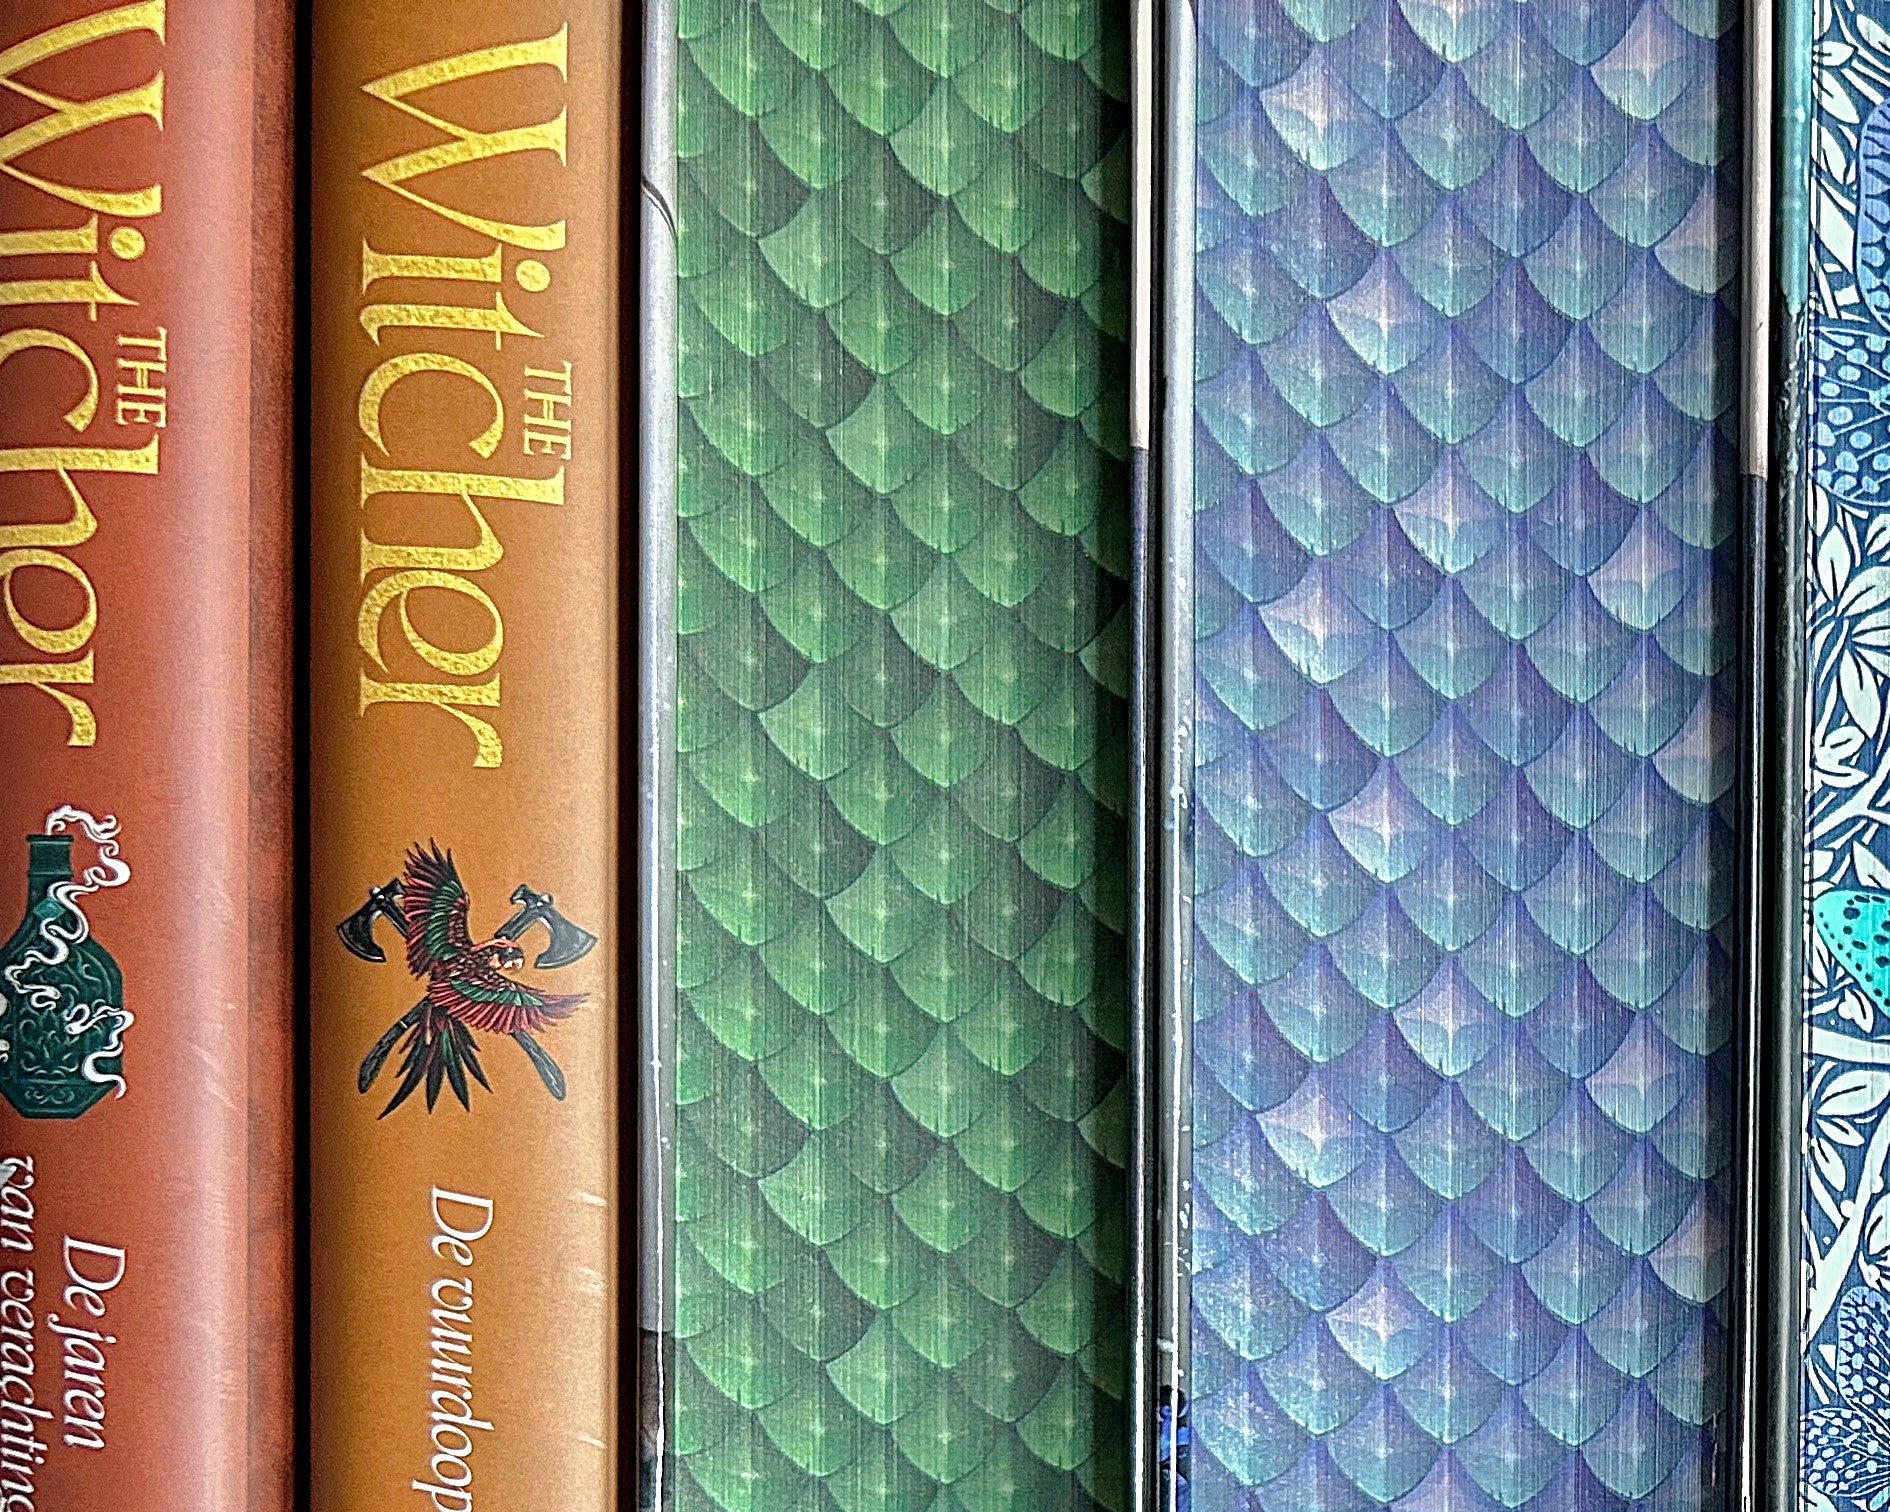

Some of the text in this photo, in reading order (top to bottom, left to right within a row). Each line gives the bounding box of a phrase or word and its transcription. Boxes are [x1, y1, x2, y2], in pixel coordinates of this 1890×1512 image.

[0, 0, 166, 747] Witcher
[117, 326, 168, 428] THE
[358, 21, 568, 769] Witcher
[522, 360, 572, 461] THE
[430, 1184, 494, 1268] De
[47, 1234, 126, 1450] De jaren
